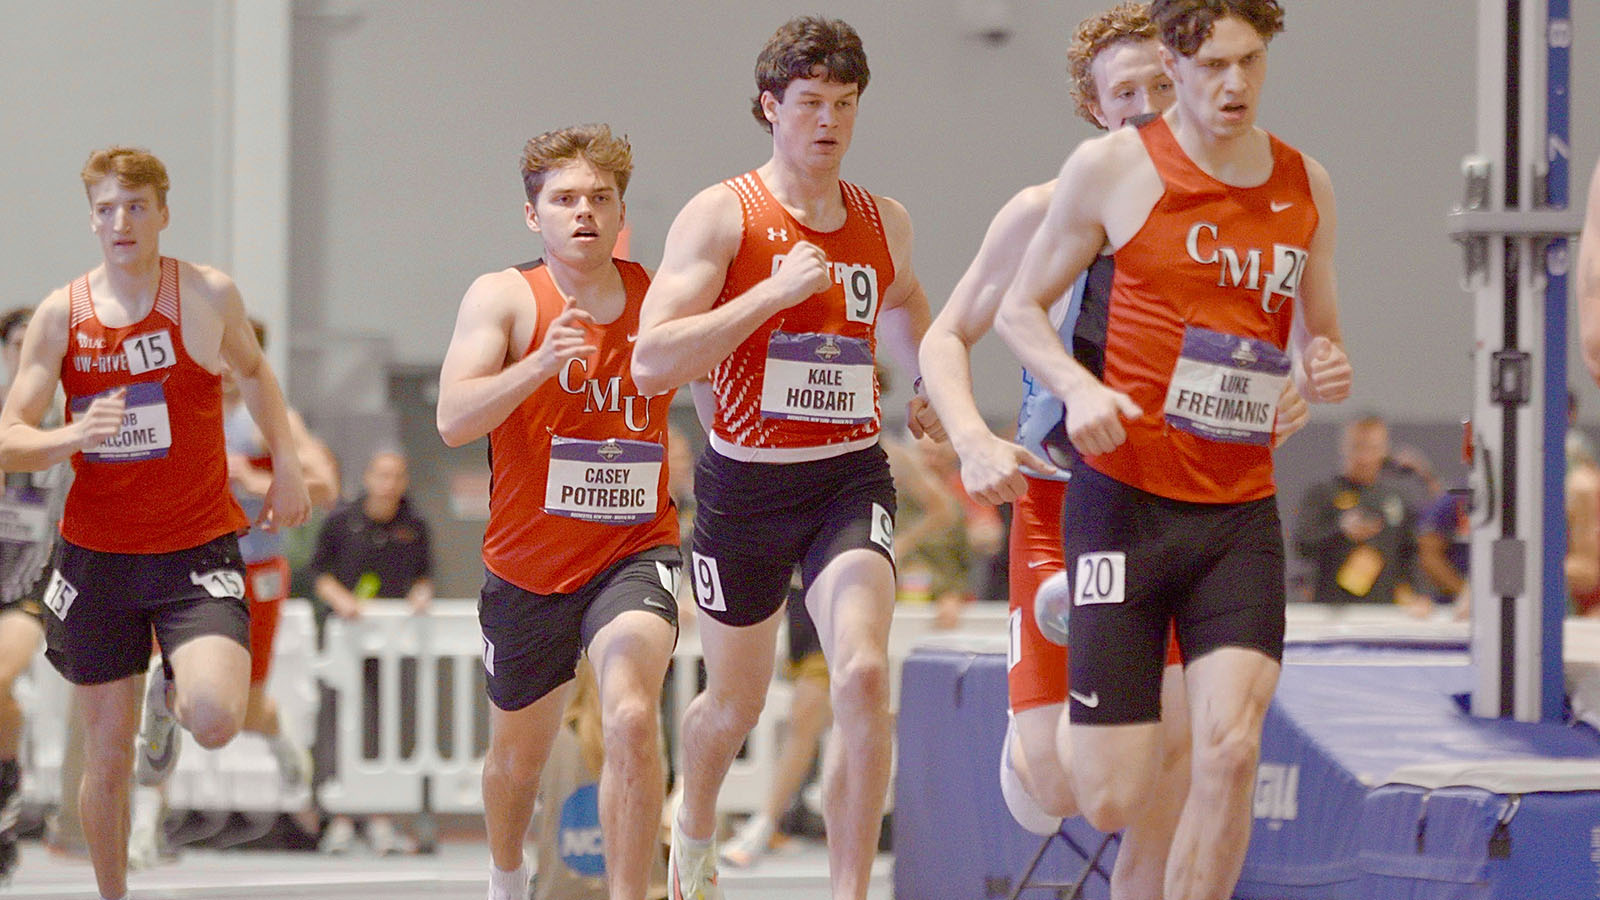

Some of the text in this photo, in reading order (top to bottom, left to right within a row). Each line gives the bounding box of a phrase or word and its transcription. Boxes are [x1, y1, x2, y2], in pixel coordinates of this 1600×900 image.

[851, 270, 872, 319] 9
[74, 354, 128, 372] UW-RIVE
[134, 335, 167, 369] 15
[808, 368, 842, 386] KALE
[1220, 374, 1250, 394] LUKE
[558, 357, 668, 431] CMU
[786, 387, 856, 412] HOBART
[1176, 388, 1269, 424] FREIMANIS
[585, 467, 631, 484] CASEY
[560, 485, 645, 508] POTREBIC
[211, 573, 240, 597] 15
[698, 558, 715, 606] 9
[1082, 557, 1114, 598] 20
[50, 580, 73, 614] 15
